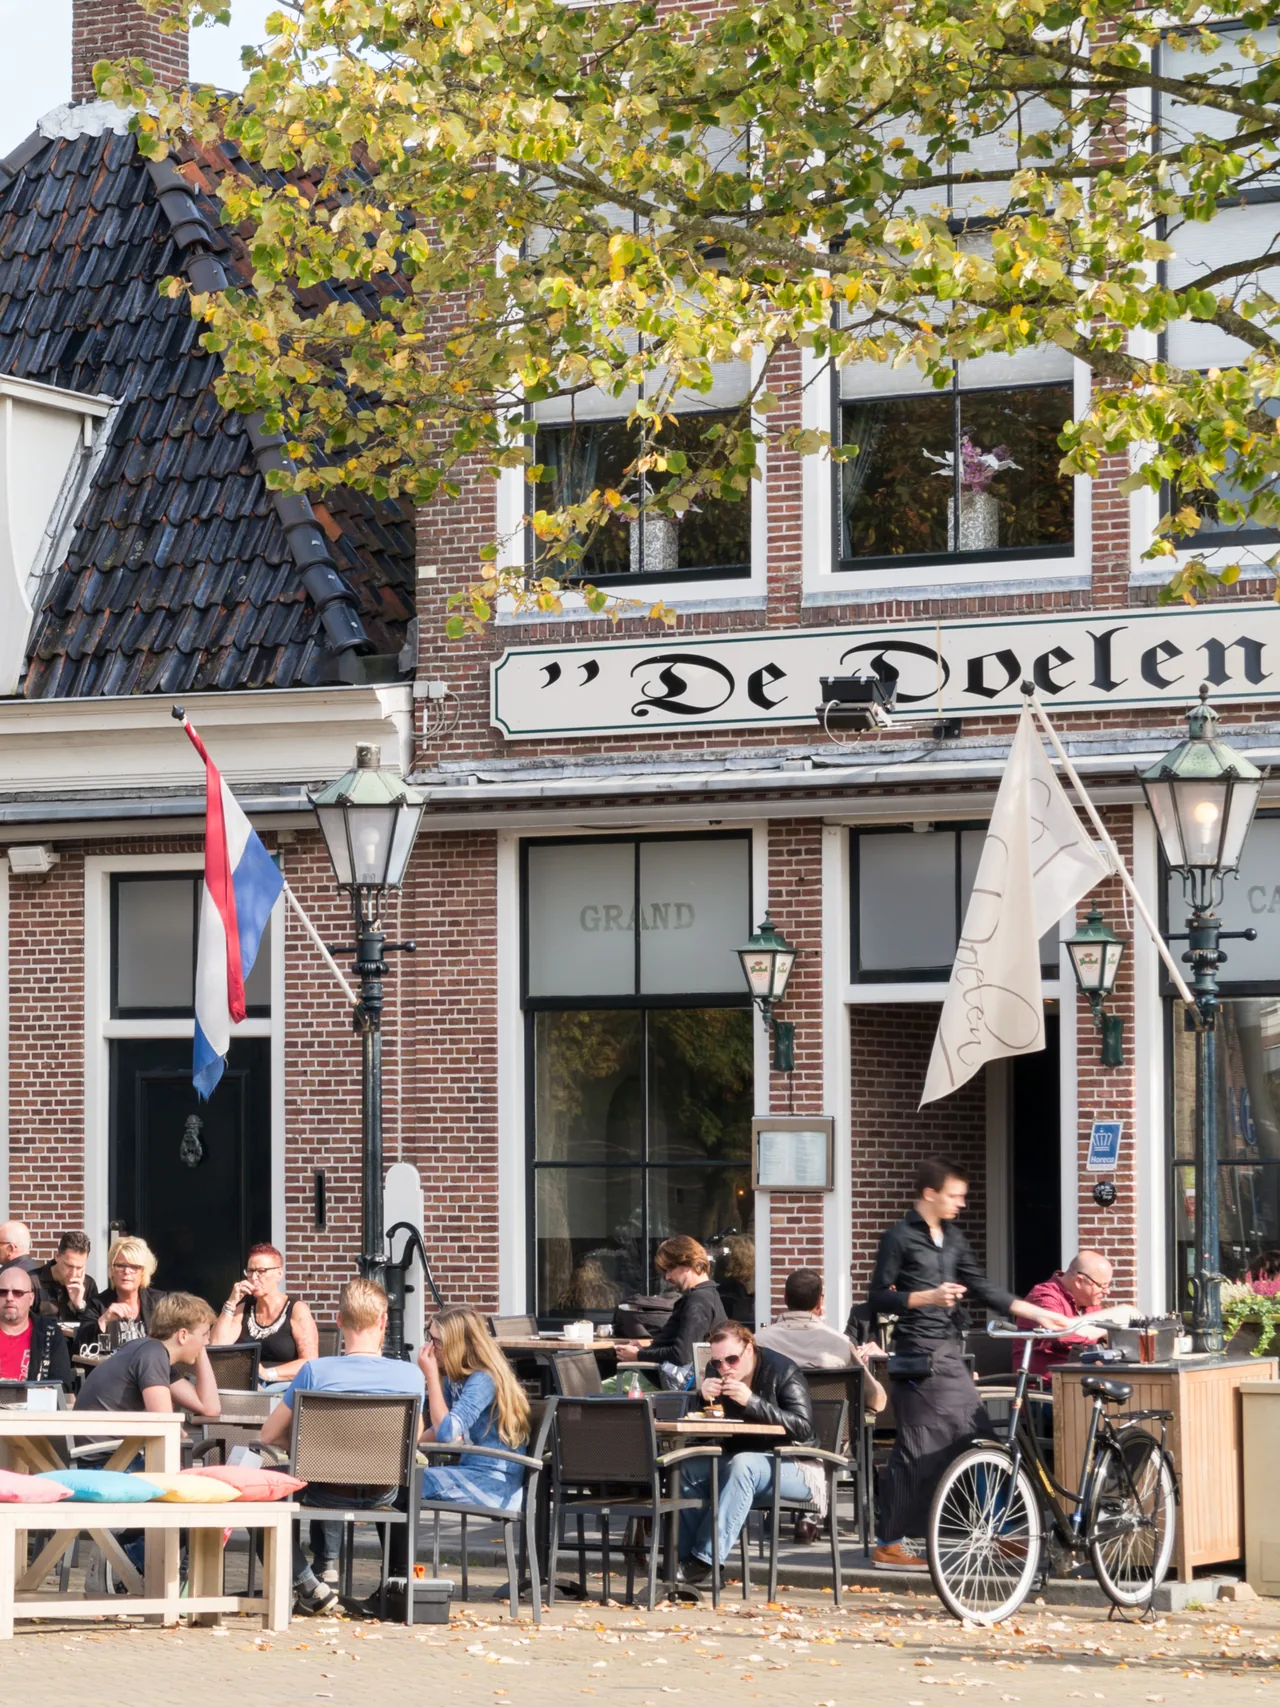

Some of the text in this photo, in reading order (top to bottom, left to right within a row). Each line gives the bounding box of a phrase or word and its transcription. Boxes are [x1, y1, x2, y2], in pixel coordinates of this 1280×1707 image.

[839, 626, 1274, 704] Doelen
[579, 902, 696, 932] GRAND
[1090, 1155, 1115, 1164] Horeca
